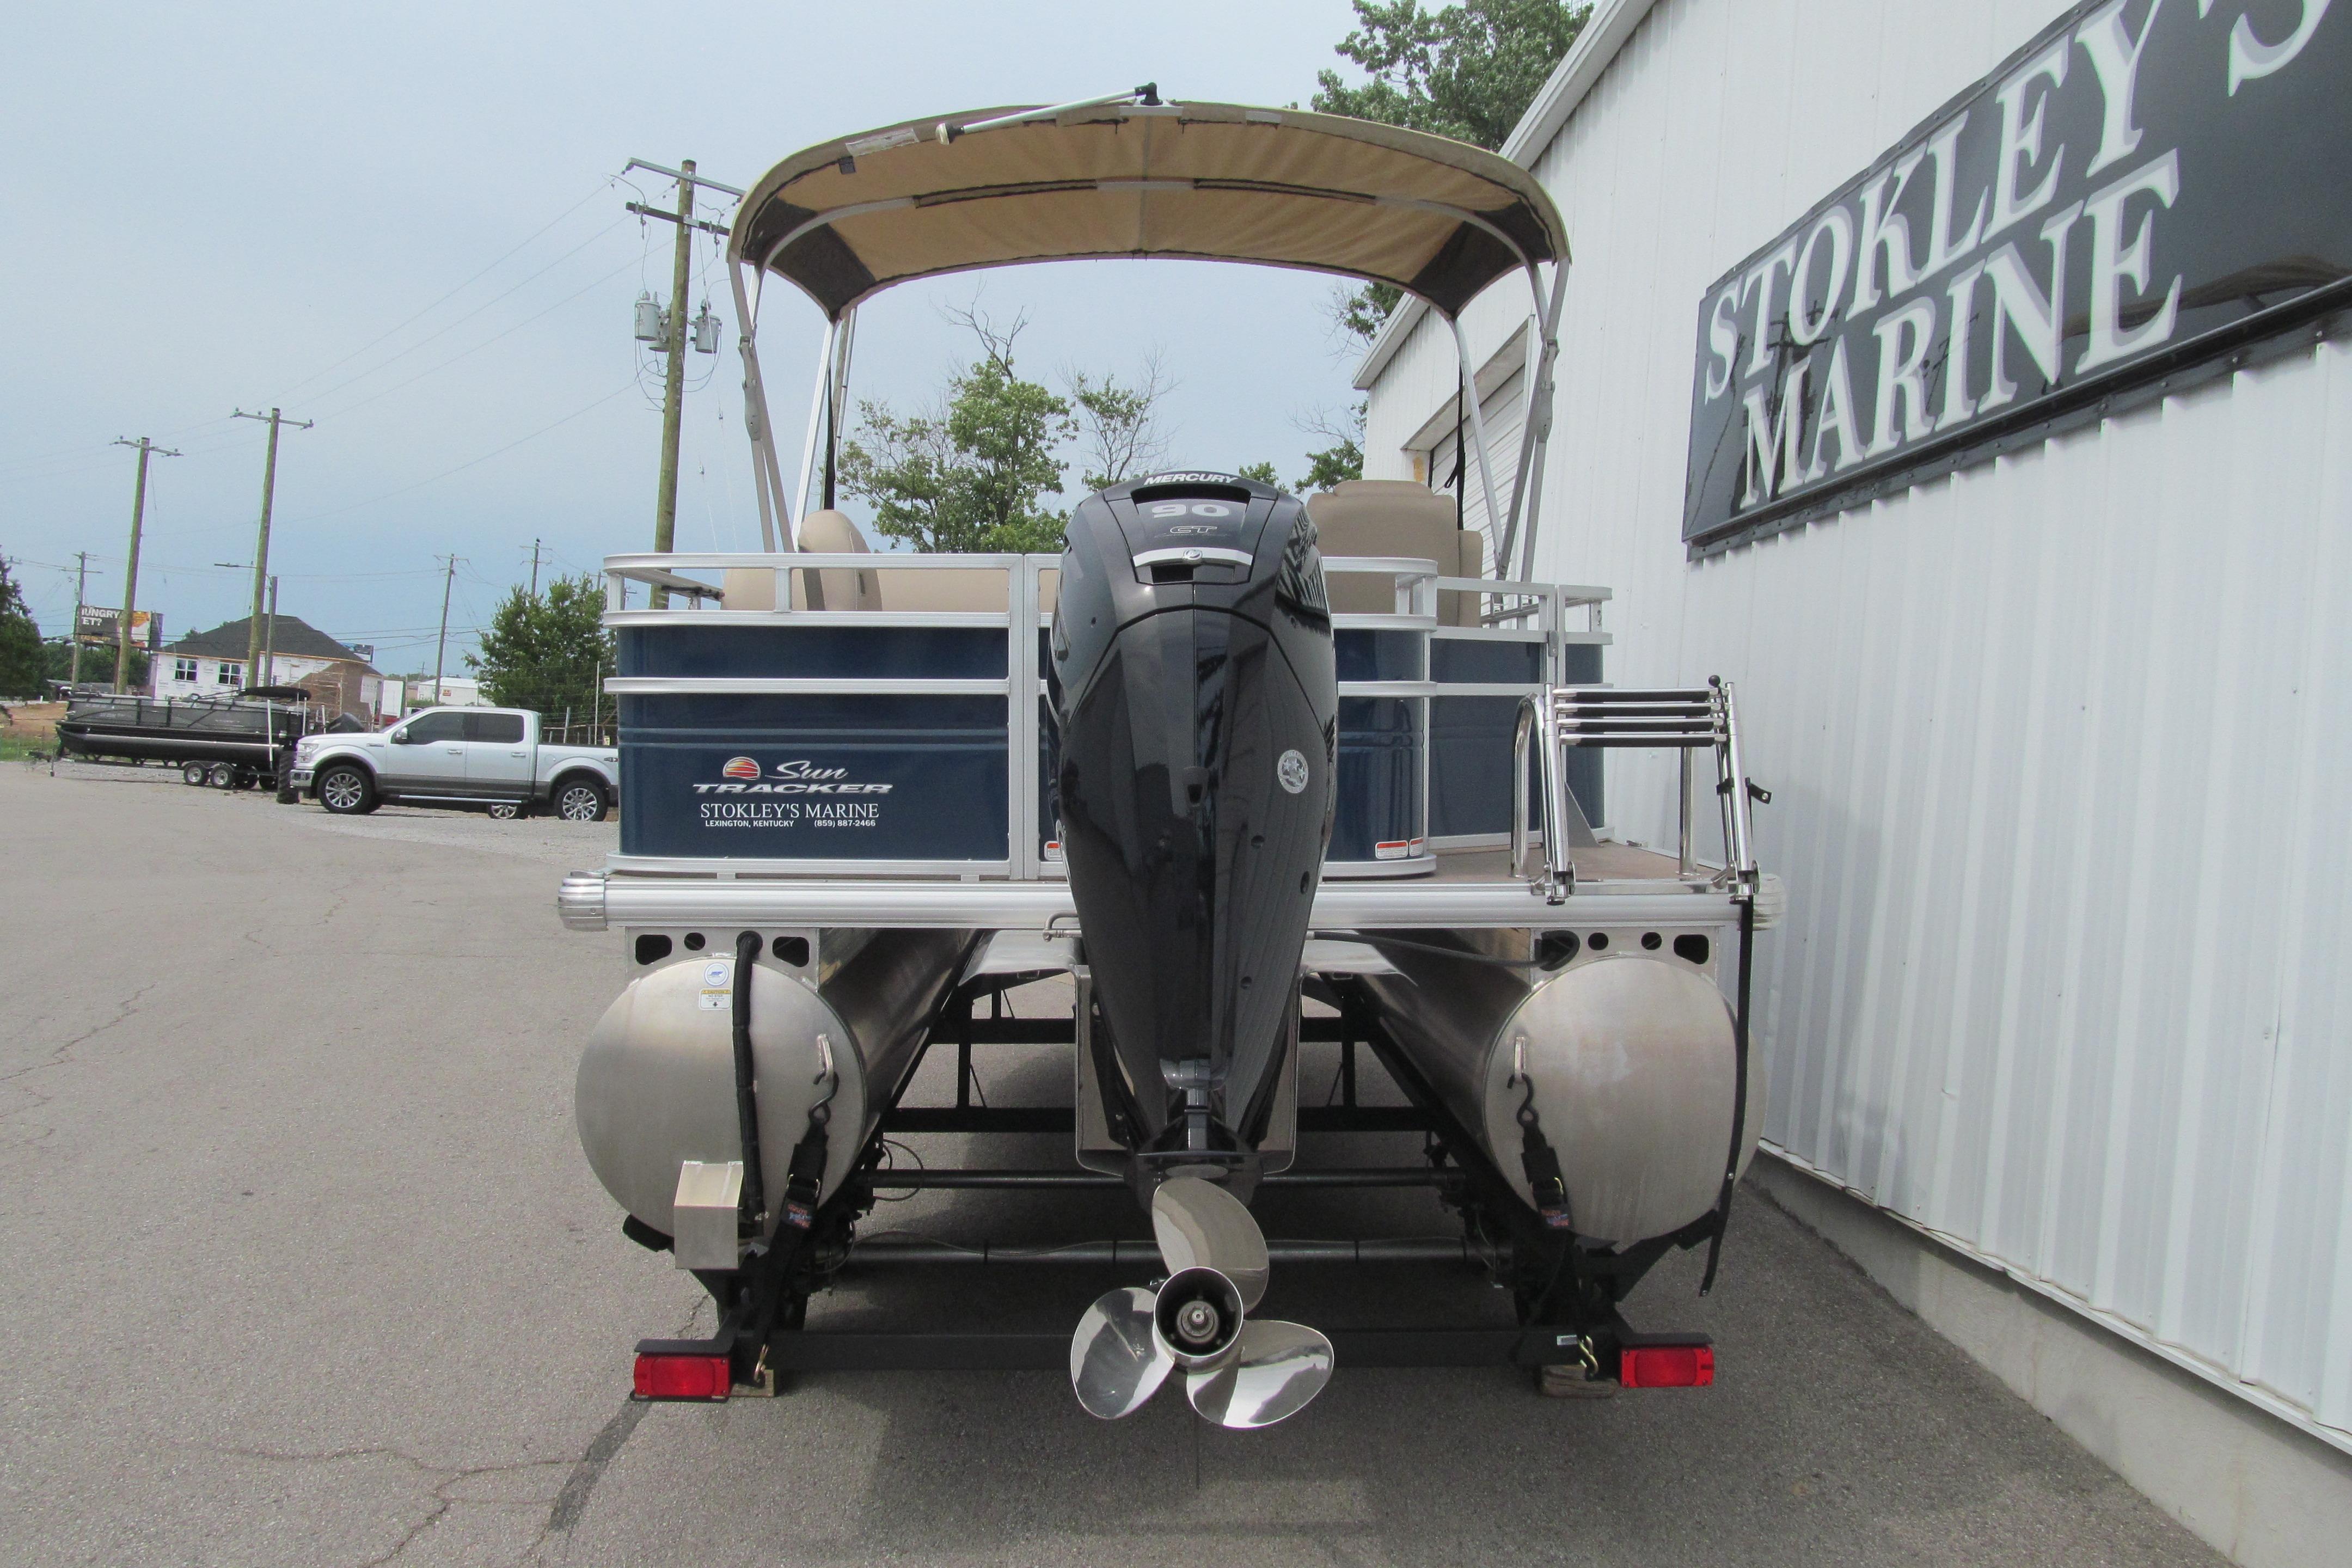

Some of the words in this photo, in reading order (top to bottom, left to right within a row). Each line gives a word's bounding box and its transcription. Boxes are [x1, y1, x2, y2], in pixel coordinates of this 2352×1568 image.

[1705, 0, 2333, 405] STOKLEY
[1739, 148, 2181, 511] MARINE
[1143, 474, 1239, 486] MERCURY
[1152, 504, 1230, 518] 90
[81, 616, 102, 626] ET?
[764, 760, 849, 780] Sun
[692, 783, 893, 794] TRACKER
[700, 803, 800, 818] STOKLEY'S
[805, 803, 880, 818] MARINE
[705, 820, 751, 828] LEXINGTON,
[814, 819, 836, 828] (859)
